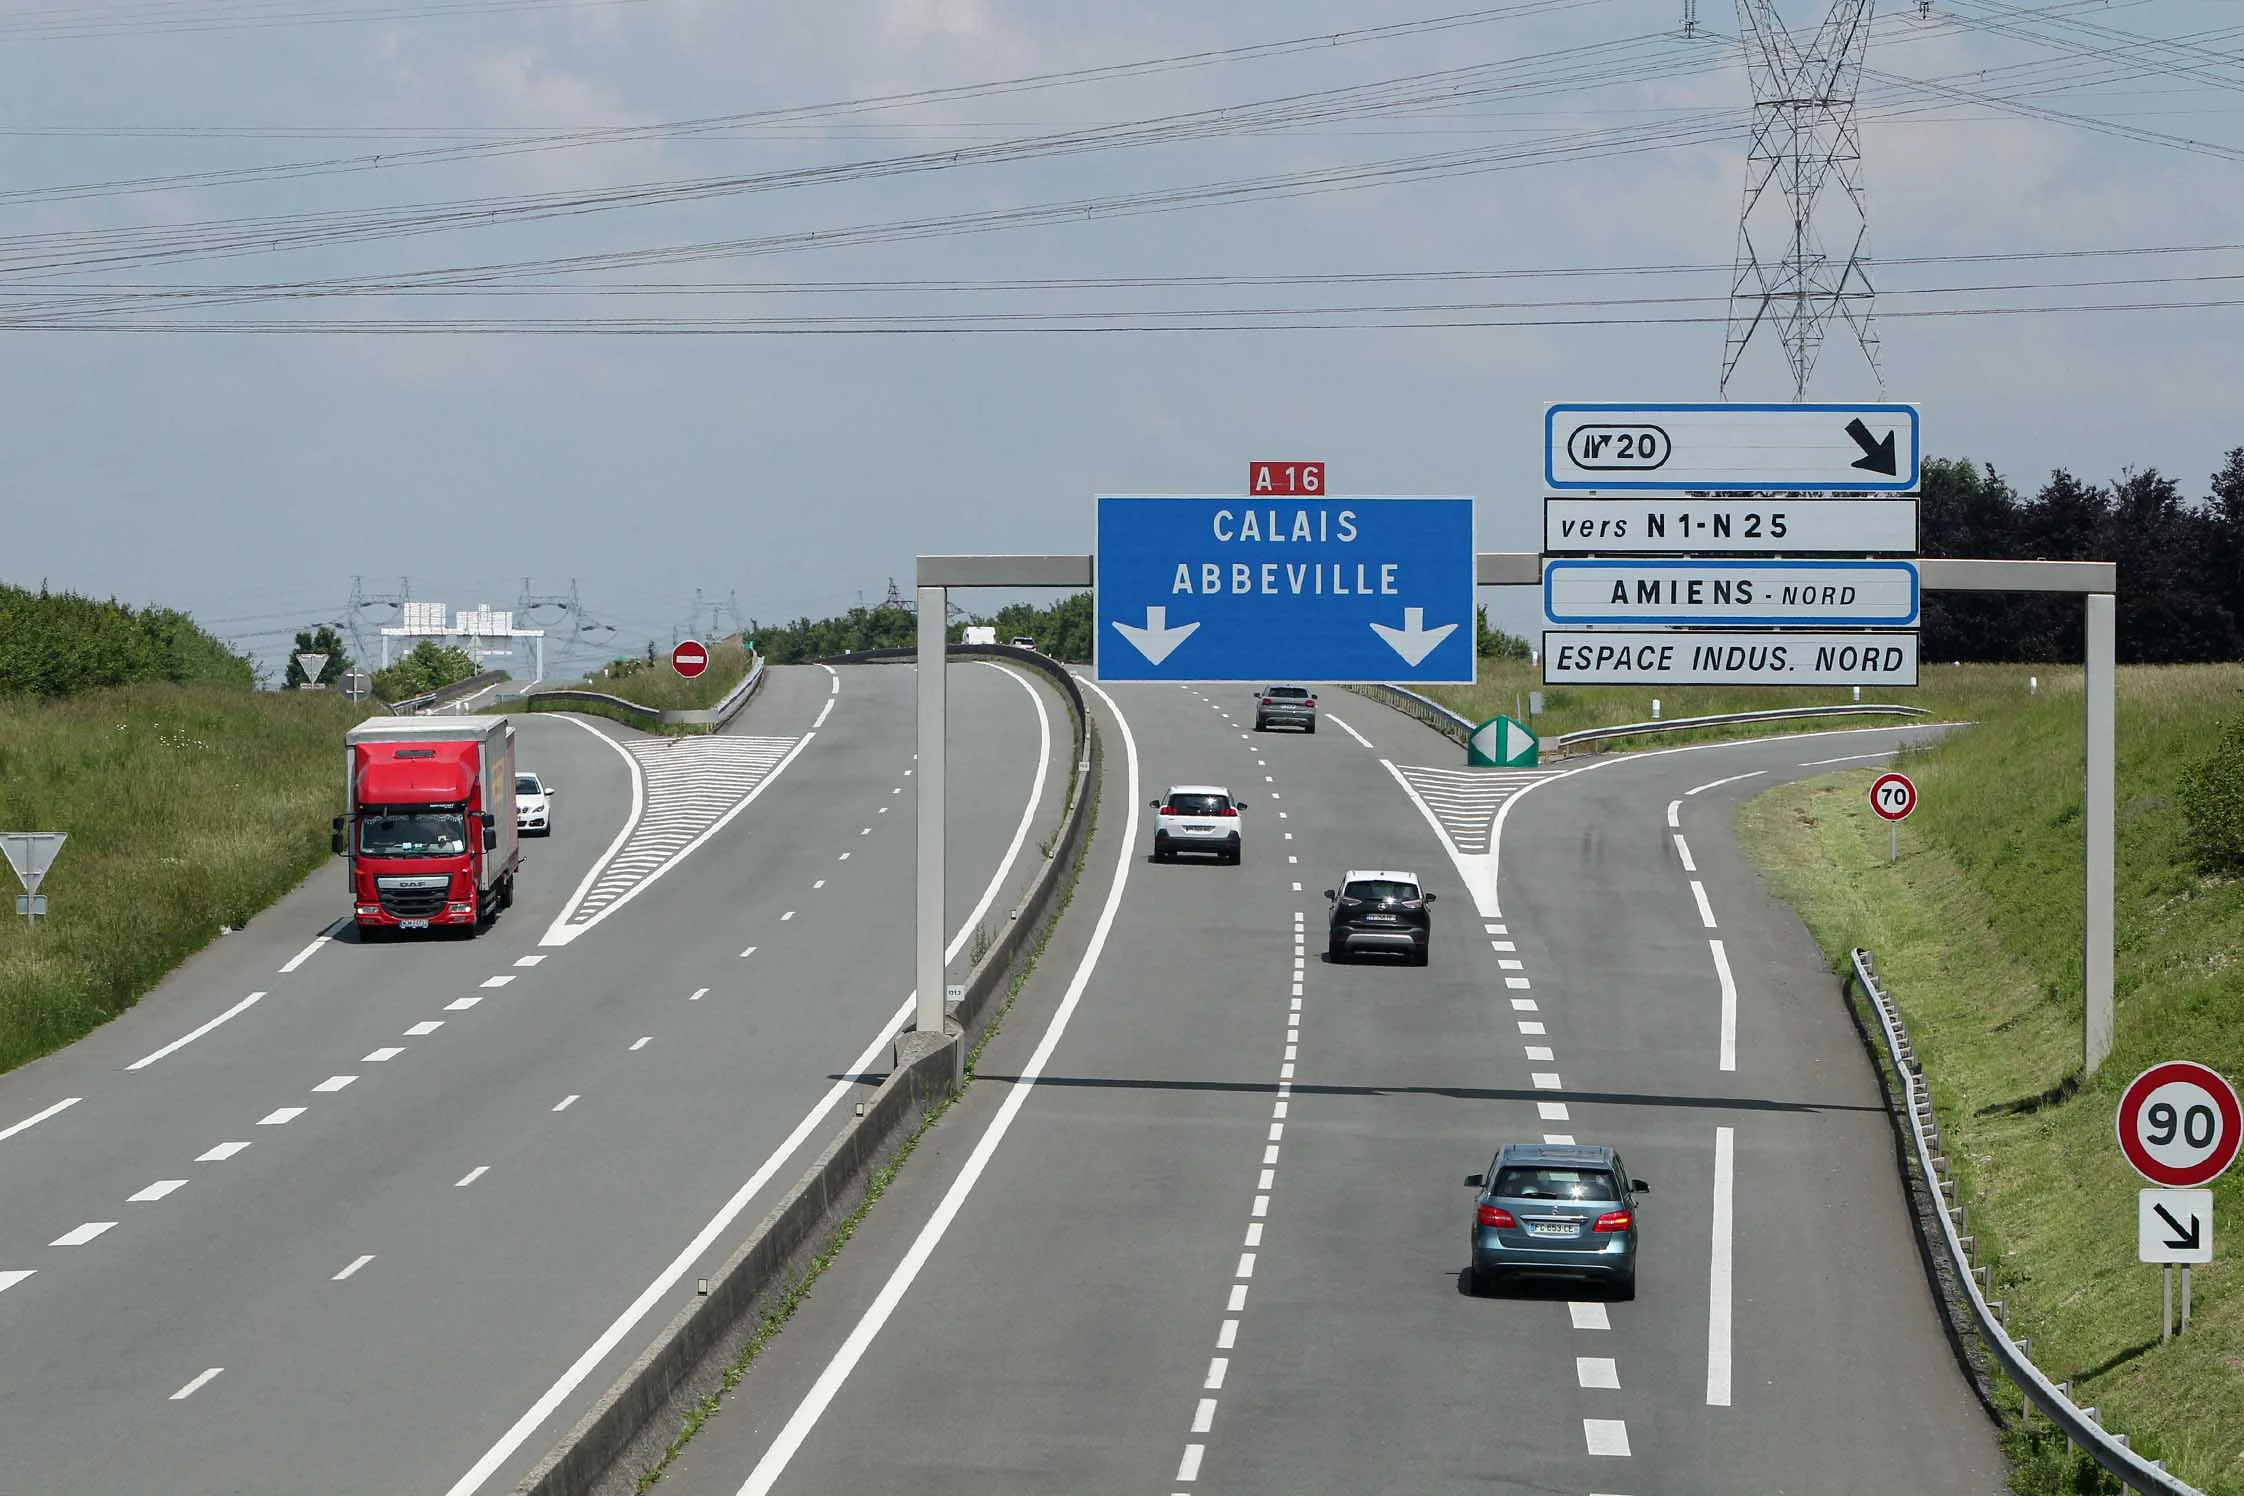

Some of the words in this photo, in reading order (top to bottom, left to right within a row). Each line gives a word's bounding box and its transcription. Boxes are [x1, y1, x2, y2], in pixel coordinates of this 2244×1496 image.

[1617, 434, 1656, 459] 20
[1213, 509, 1358, 542] CALAIS
[1561, 519, 1628, 538] vers
[1172, 563, 1399, 594] ABBEVILLE
[1556, 645, 1674, 671] ESPACE
[1692, 646, 1795, 671] INDUS.
[1815, 646, 1904, 672] NORD
[1881, 788, 1907, 806] 70
[2146, 1102, 2216, 1149] 90
